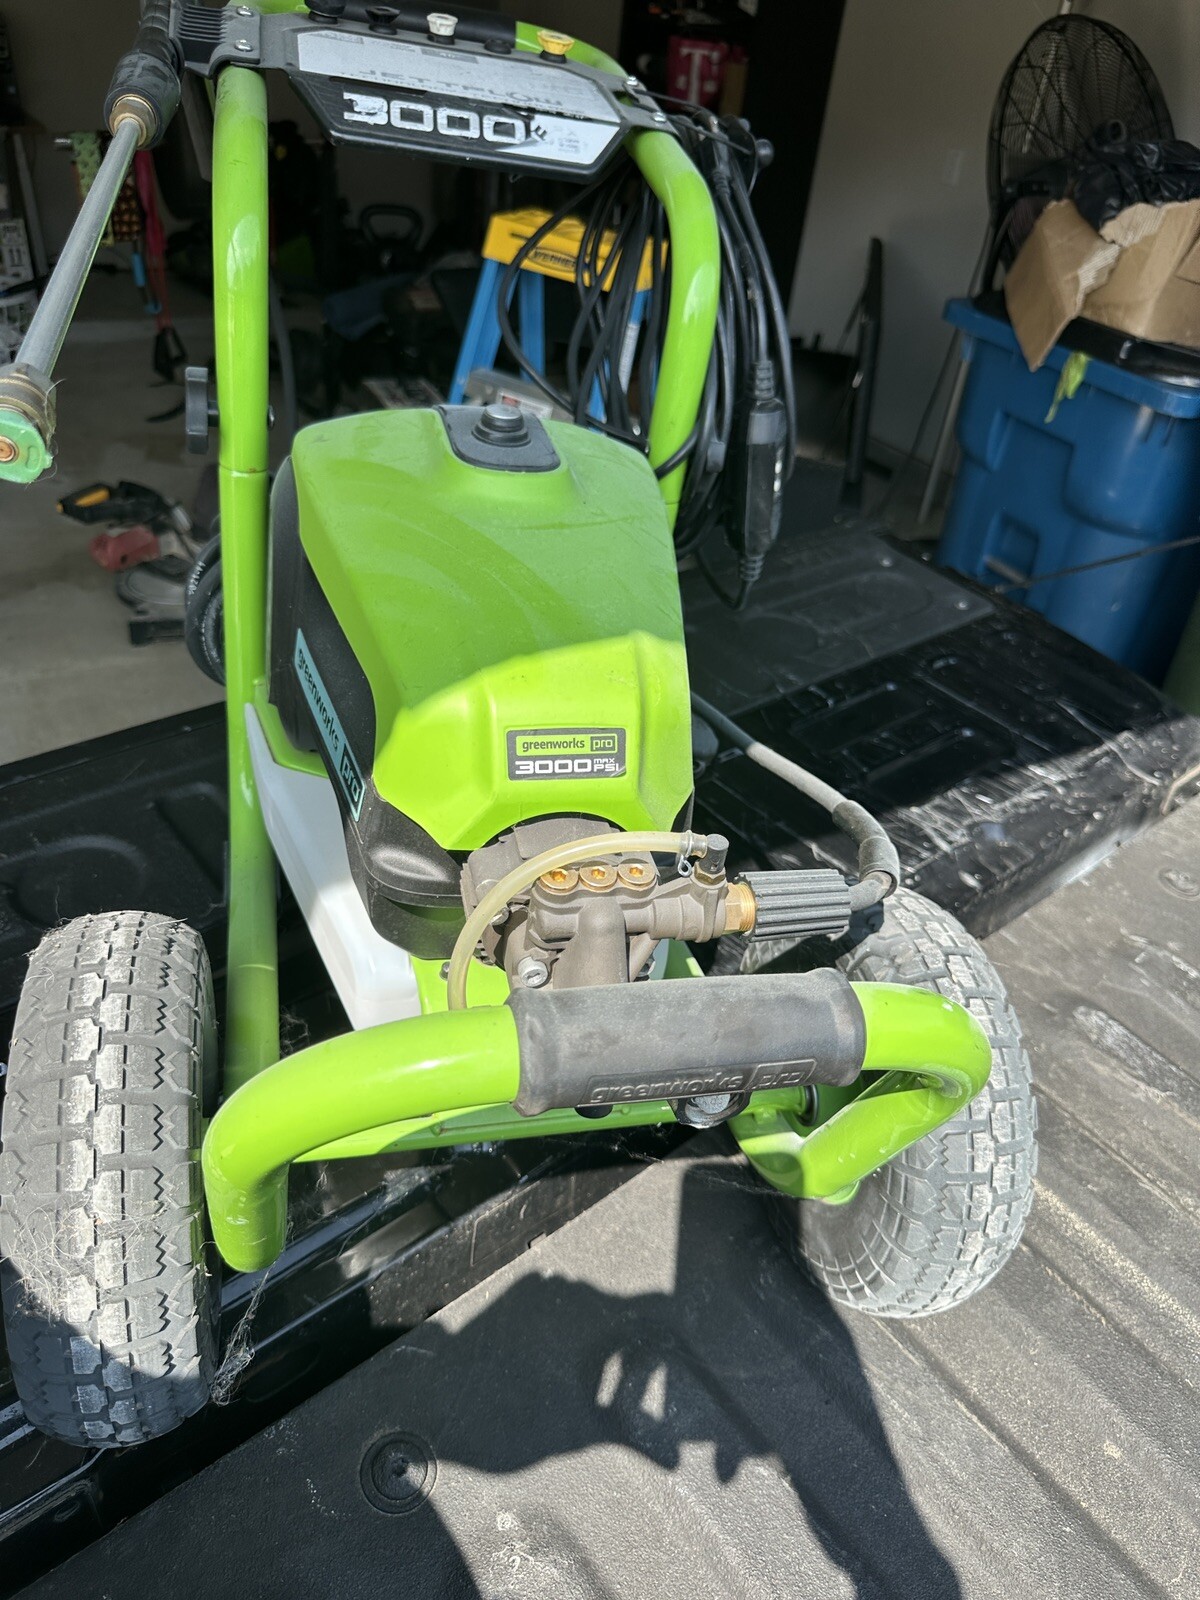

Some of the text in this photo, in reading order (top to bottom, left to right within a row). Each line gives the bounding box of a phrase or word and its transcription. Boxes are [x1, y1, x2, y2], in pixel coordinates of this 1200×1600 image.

[342, 91, 527, 146] 3000
[297, 647, 361, 802] greenworks pro
[522, 738, 613, 752] greenworks pro
[514, 758, 592, 775] 3000
[593, 763, 620, 772] PSI
[590, 1071, 806, 1103] greenworks pro
